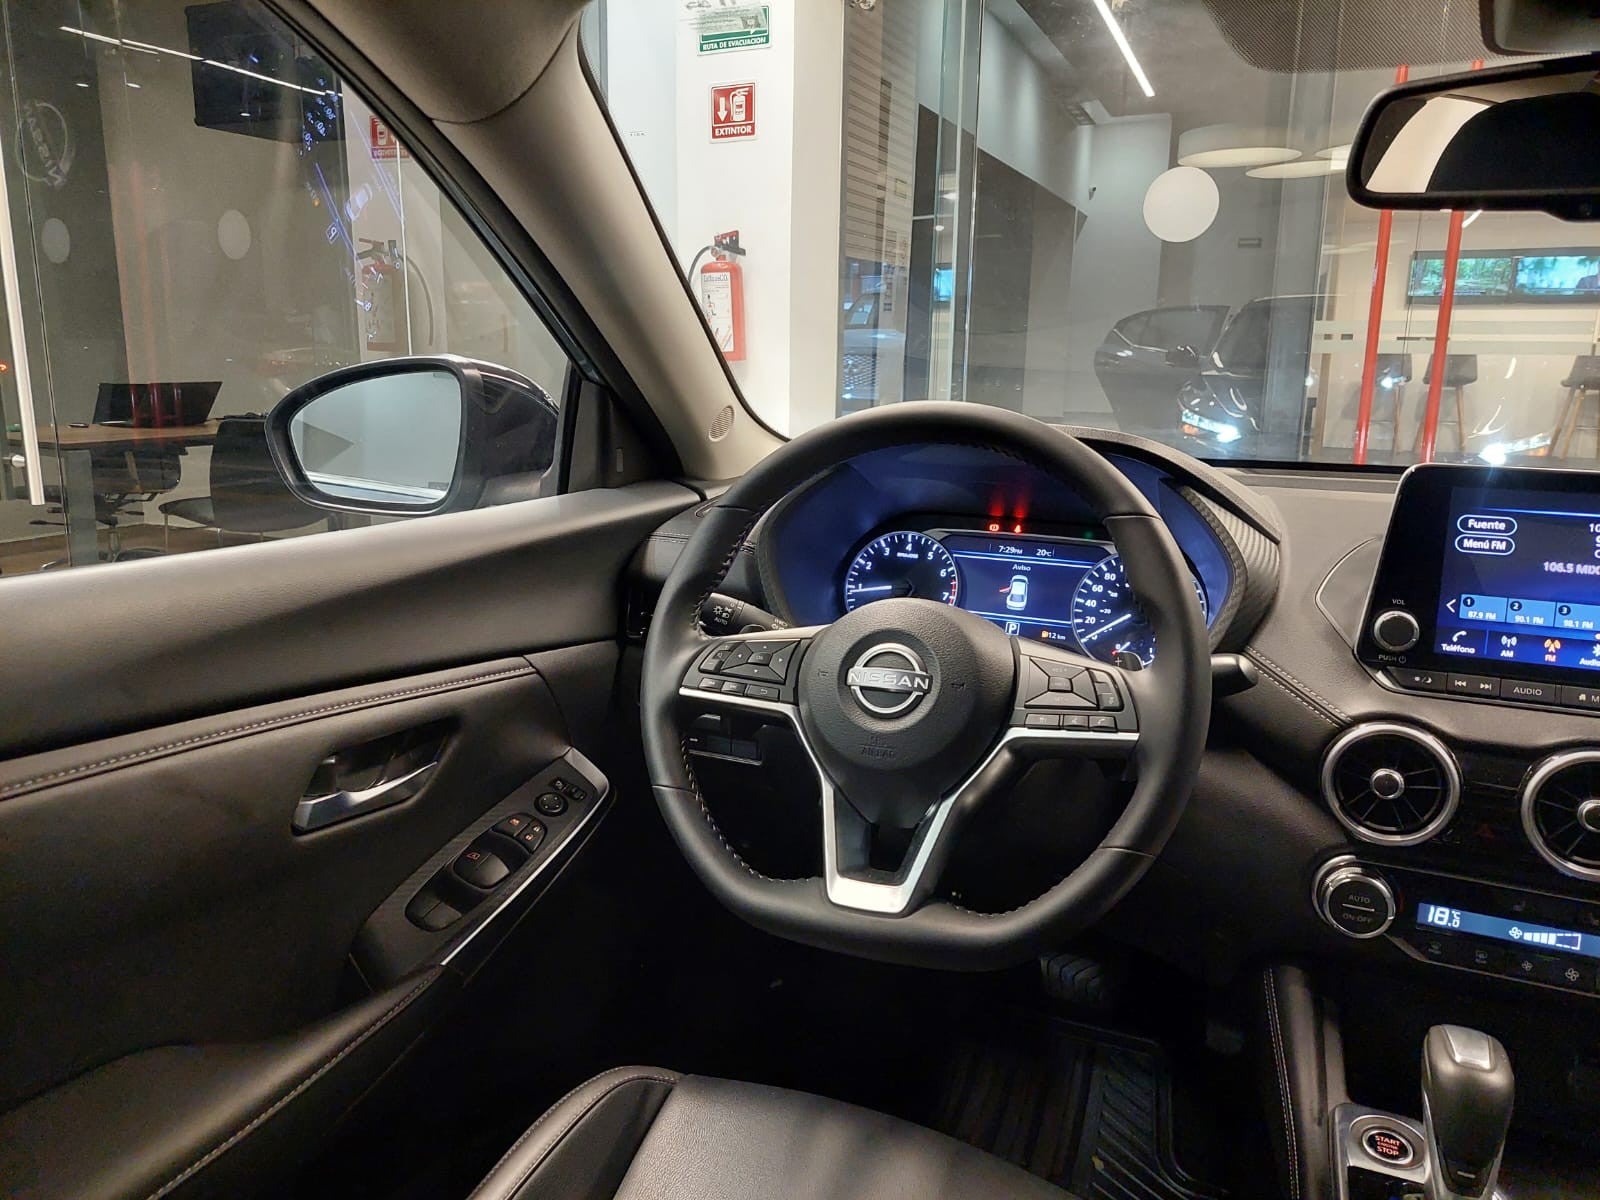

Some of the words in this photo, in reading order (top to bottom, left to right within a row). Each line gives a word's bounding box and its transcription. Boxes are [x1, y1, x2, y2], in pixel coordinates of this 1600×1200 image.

[703, 43, 718, 51] RUTA
[719, 41, 728, 49] DE
[715, 125, 752, 136] EXTINTOR
[1468, 519, 1506, 531] Fuente
[905, 543, 912, 551] 4
[1463, 538, 1489, 550] Menú
[1491, 540, 1506, 551] FM
[884, 547, 890, 556] 3
[927, 551, 934, 560] 5
[865, 562, 872, 570] 2
[1012, 563, 1031, 572] Aviso
[1543, 561, 1574, 574] 106.5
[940, 568, 947, 577] 6
[1104, 572, 1117, 581] 80
[1092, 584, 1103, 592] 60
[942, 592, 949, 601] 7
[1085, 599, 1096, 608] 40
[1085, 616, 1096, 624] 20
[1485, 612, 1497, 620] FM
[1533, 616, 1544, 625] FM
[1582, 621, 1593, 629] FM
[1500, 650, 1514, 658] AM
[1544, 654, 1557, 662] FM
[849, 671, 930, 690] NISSAN
[1513, 686, 1543, 696] AUDIO
[1349, 894, 1371, 904] AUTO
[1375, 1136, 1400, 1146] START
[1377, 1146, 1399, 1155] STOP
